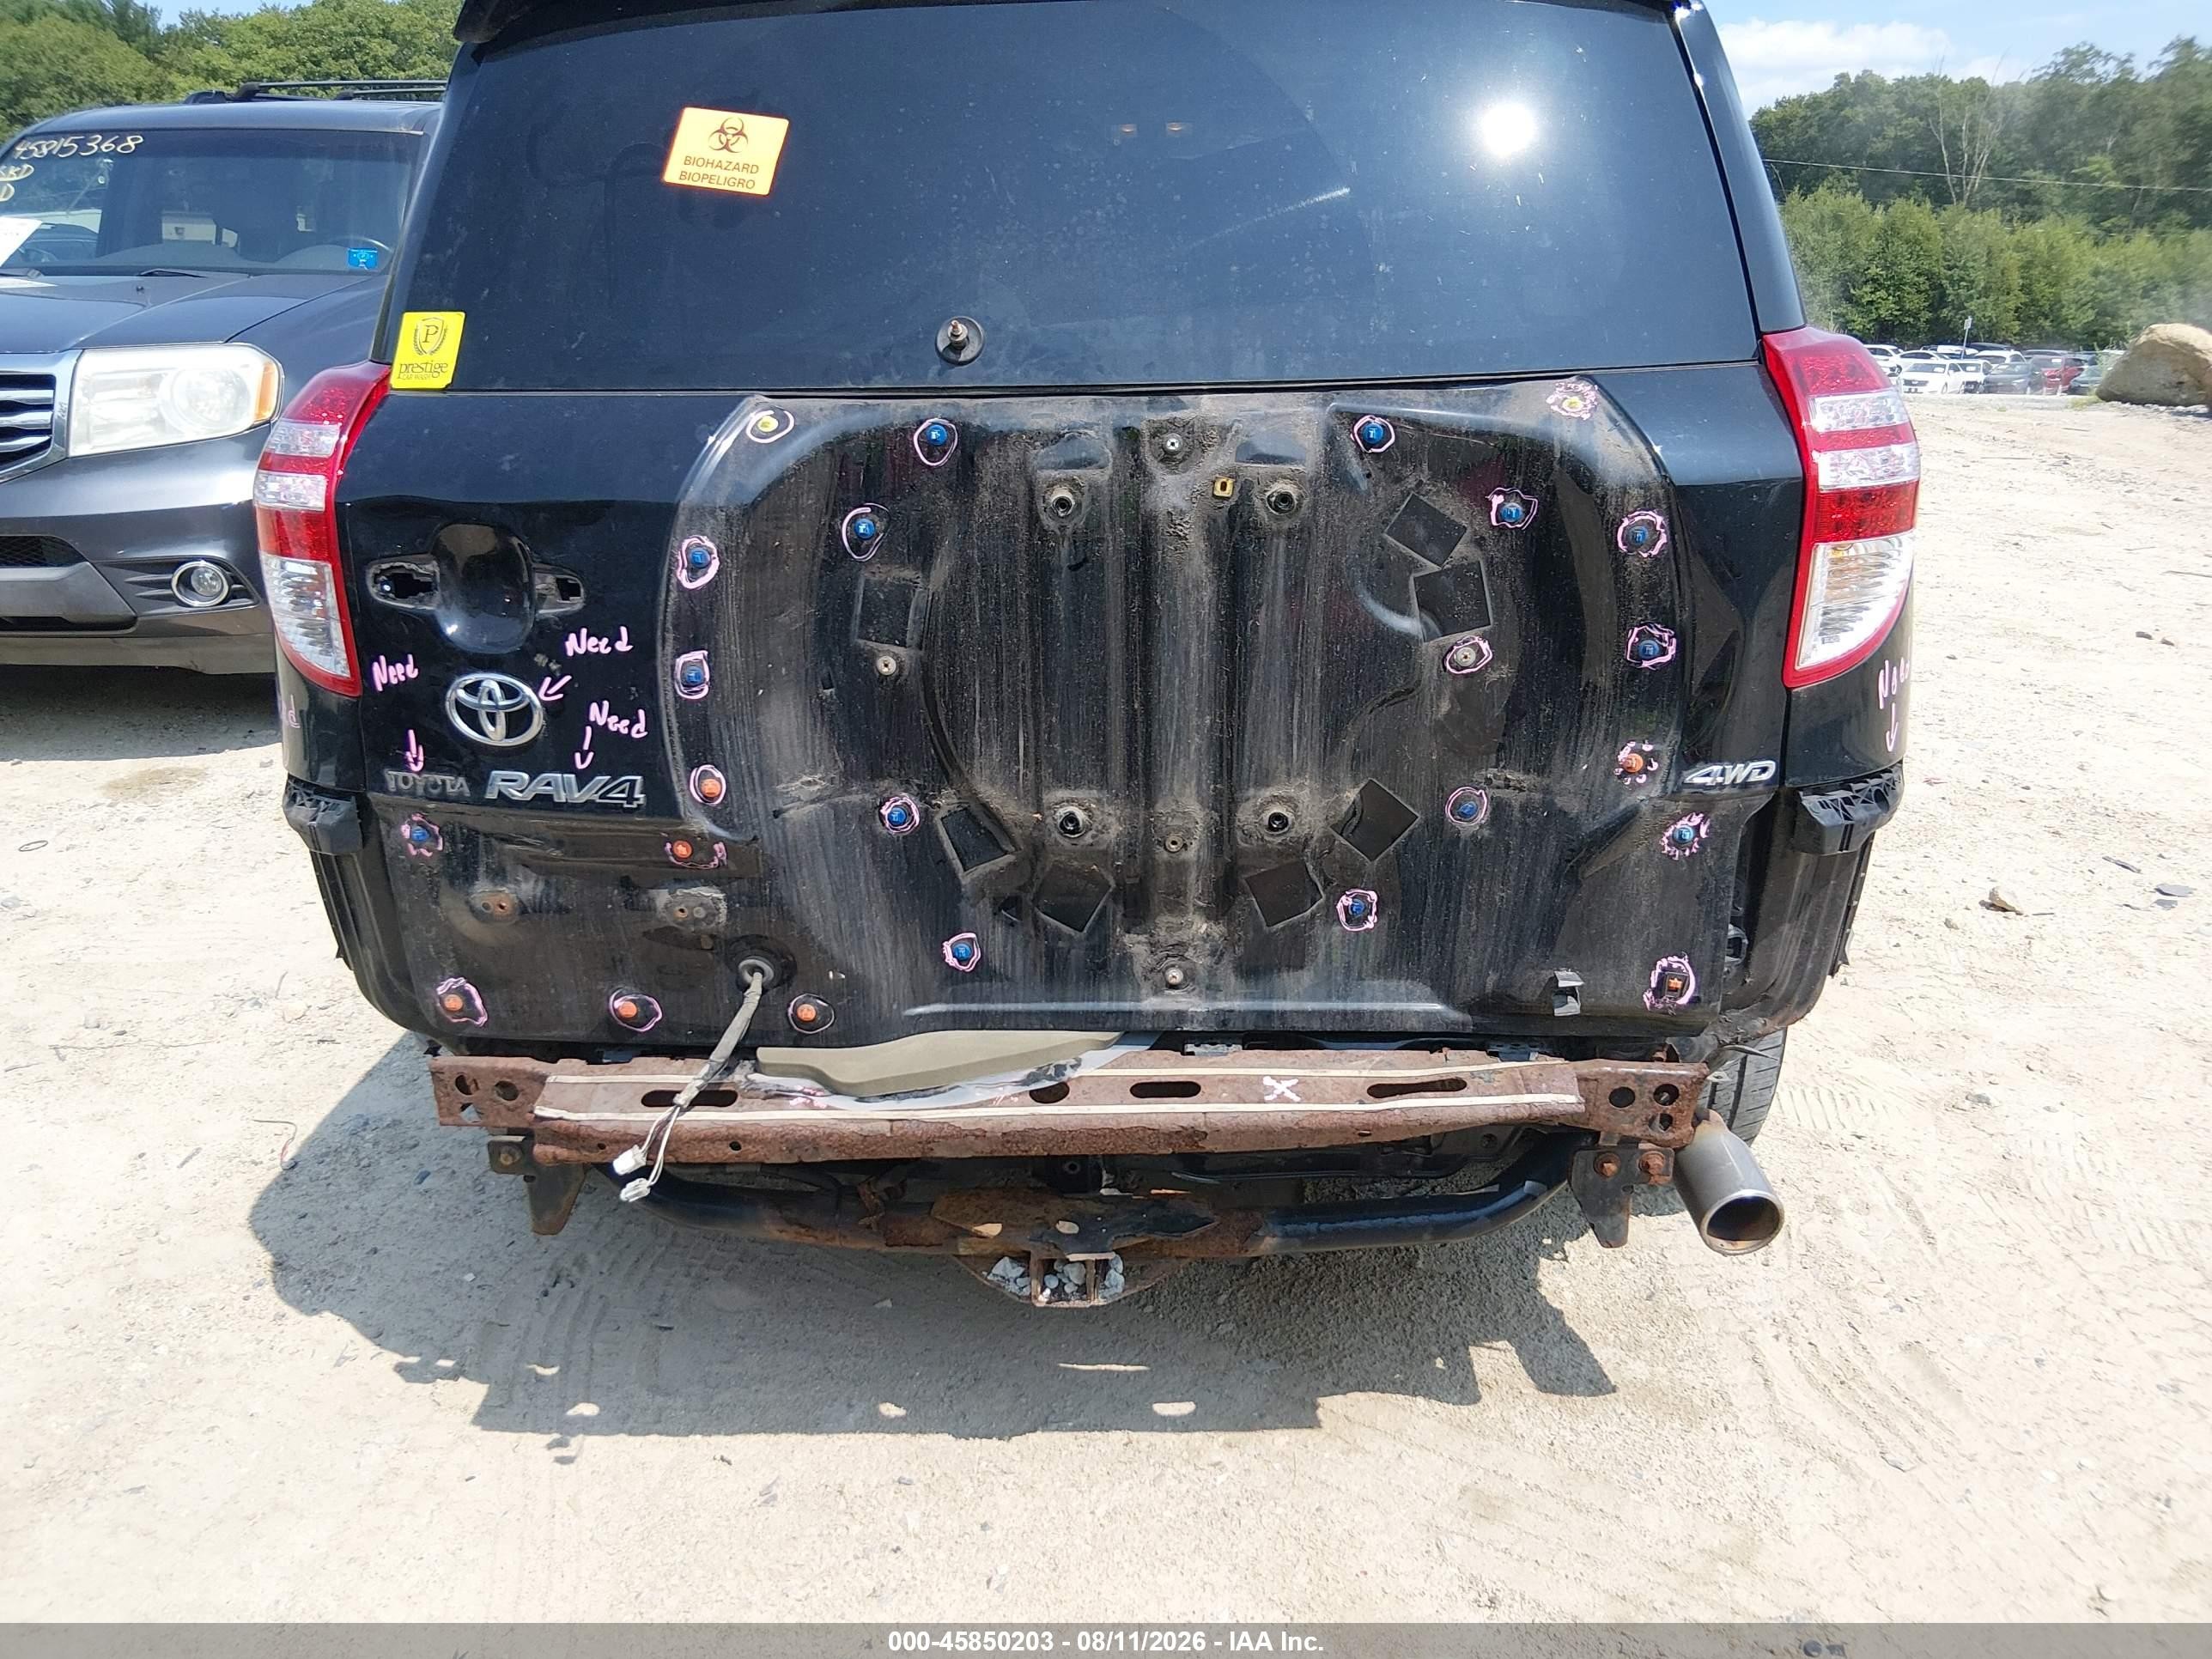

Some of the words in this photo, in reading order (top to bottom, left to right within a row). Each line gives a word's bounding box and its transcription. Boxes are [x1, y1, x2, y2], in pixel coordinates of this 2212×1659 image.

[684, 155, 759, 173] BIOHAZARD
[679, 171, 756, 190] BIOPELIGRO
[422, 325, 439, 343] P
[398, 360, 448, 379] prestige
[565, 627, 633, 656] Need
[372, 654, 419, 691] Need
[590, 701, 647, 738] Need
[386, 771, 471, 795] TOYOTA
[1685, 761, 1776, 786] 4WD
[485, 770, 645, 807] RAV4
